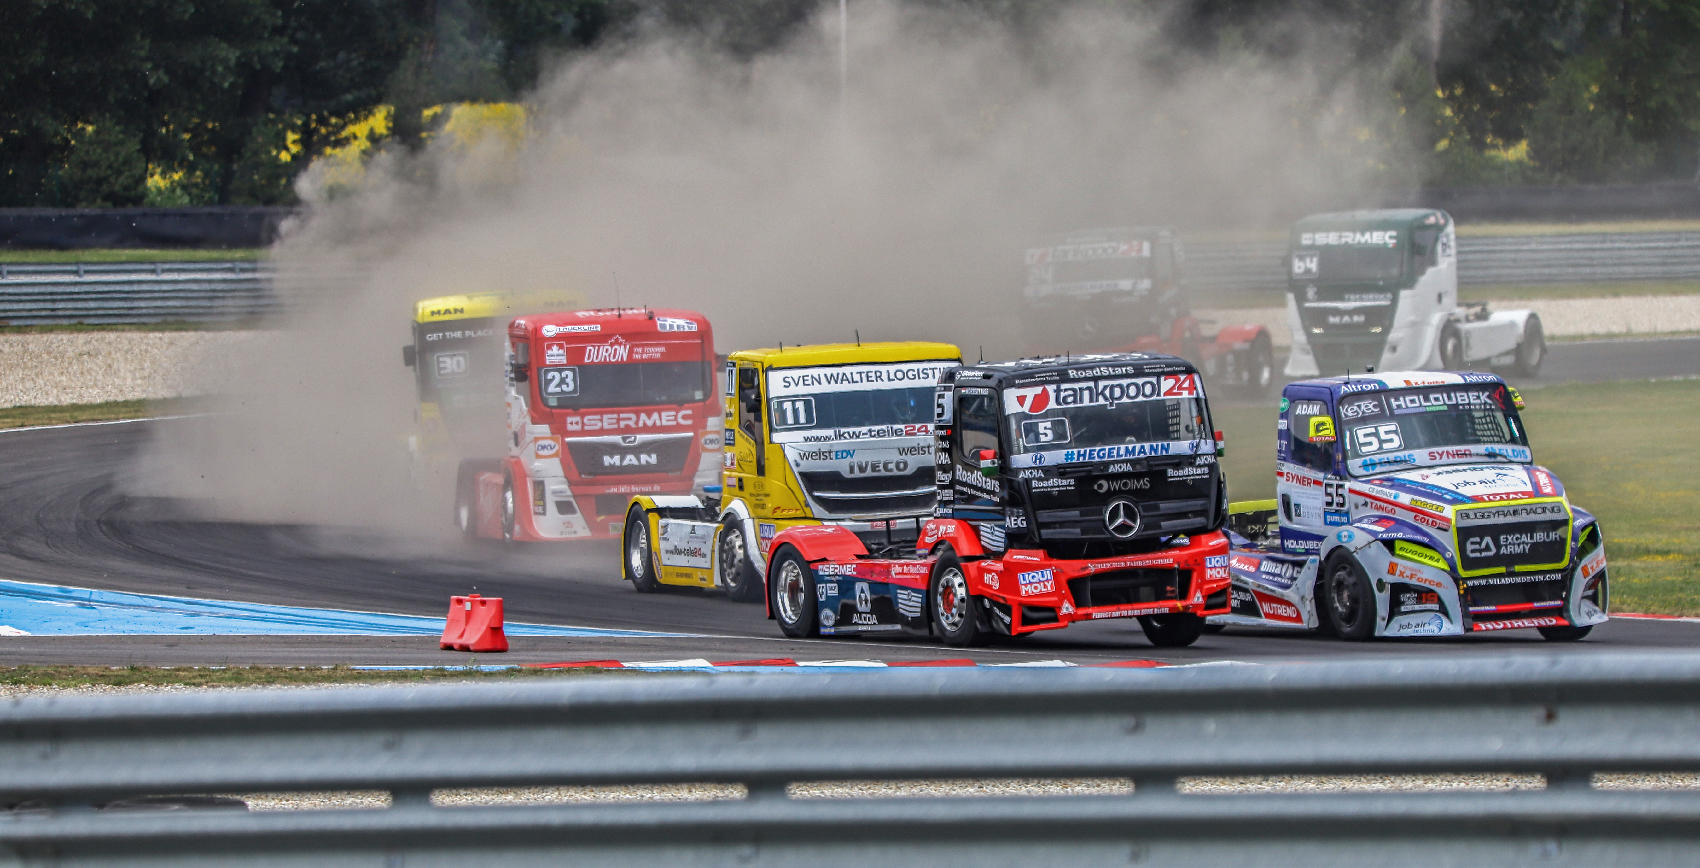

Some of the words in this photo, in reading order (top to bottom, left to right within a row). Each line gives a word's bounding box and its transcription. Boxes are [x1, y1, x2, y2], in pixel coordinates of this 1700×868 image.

[1314, 230, 1398, 245] SERMEC
[430, 307, 464, 317] MAN
[1328, 314, 1365, 324] MAN
[426, 333, 443, 342] GET
[445, 331, 463, 340] THE
[584, 345, 630, 363] DURON
[438, 356, 466, 375] 30
[1068, 366, 1135, 379] RoadStars
[547, 370, 575, 394] 23
[782, 373, 822, 388] SVEN
[824, 370, 883, 385] WALTER
[1464, 374, 1497, 383] Altron
[1053, 376, 1162, 408] tankpool
[1163, 373, 1197, 397] 24
[1340, 382, 1379, 395] Altron
[1391, 391, 1493, 410] HOLOUBEK
[783, 400, 807, 425] 11
[1295, 404, 1320, 415] ADAM
[1339, 399, 1381, 419] KeyTec
[583, 410, 693, 430] SERMEC
[803, 424, 936, 442] www.lkw-teile24.
[1038, 421, 1054, 443] 5
[1356, 424, 1402, 453] 55
[536, 443, 557, 453] DKV
[1064, 442, 1171, 463] #HEGELMANN
[1428, 449, 1472, 461] SYNER
[1499, 448, 1529, 460] ELDIS
[603, 454, 658, 467] MAN
[848, 460, 909, 474] IVECO
[1377, 454, 1416, 467] ELDIS
[956, 464, 1000, 493] RoadStars
[1167, 466, 1210, 477] RoadStars
[1032, 478, 1075, 488] RoadStars
[1109, 477, 1150, 490] WOIMS
[1285, 471, 1313, 488] SYNER
[1324, 482, 1346, 508] 55
[1483, 493, 1529, 502] TOTAL
[1369, 501, 1397, 515] TANGO
[1460, 510, 1513, 520] BUGGYRA
[1520, 505, 1561, 516] RACING
[1006, 516, 1027, 528] AEG
[1500, 530, 1560, 545] EXCALIBUR
[1399, 546, 1441, 563] BUGGYRA
[1500, 544, 1531, 555] ARMY
[1206, 556, 1229, 568] LIQUI
[824, 564, 857, 575] SERMEC
[1019, 569, 1052, 585] LIQUI
[1467, 573, 1562, 587] WWW.VILADUMDEVIN.COM
[1021, 580, 1054, 595] MOLY
[1422, 592, 1439, 604] 19
[1262, 602, 1297, 618] NUTREND
[852, 613, 878, 625] ALCOA
[1397, 622, 1413, 632] job
[1414, 620, 1428, 629] air
[1478, 615, 1557, 631] NUTREND
